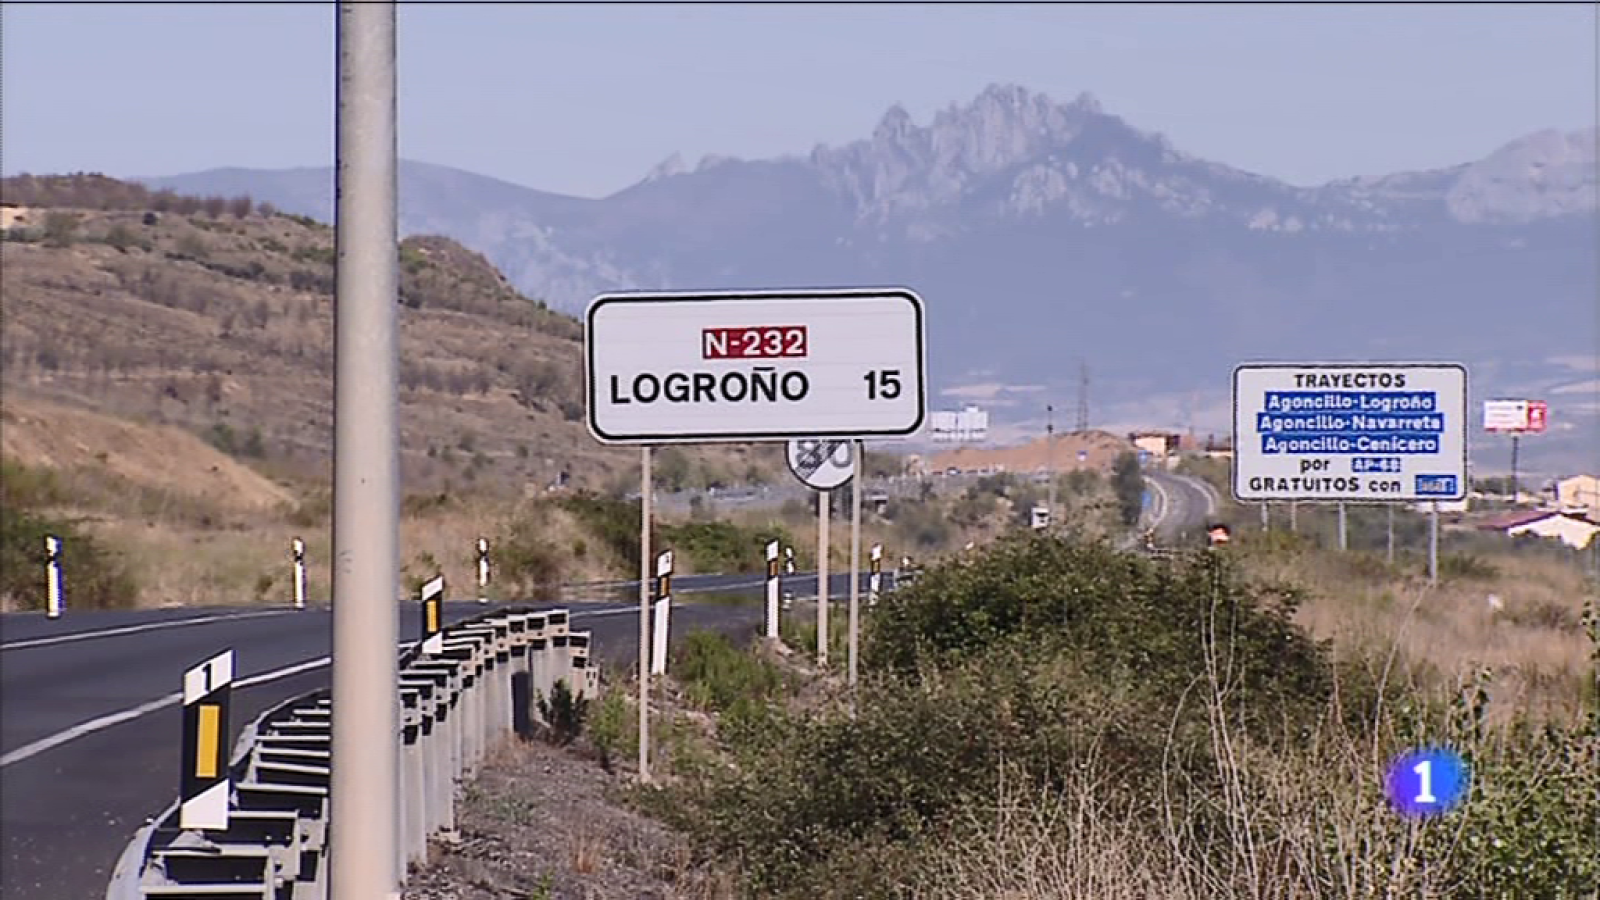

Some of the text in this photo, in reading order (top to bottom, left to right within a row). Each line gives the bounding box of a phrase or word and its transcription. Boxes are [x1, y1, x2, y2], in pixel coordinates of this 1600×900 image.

[705, 330, 804, 356] N-232
[611, 367, 901, 404] LOGROÑO 15
[1294, 373, 1406, 388] TRAYECTOS
[1268, 394, 1433, 412] Agoncillo-Logroño
[1300, 459, 1330, 473] por
[1249, 477, 1360, 492] GRATUITOS
[1368, 480, 1401, 492] con
